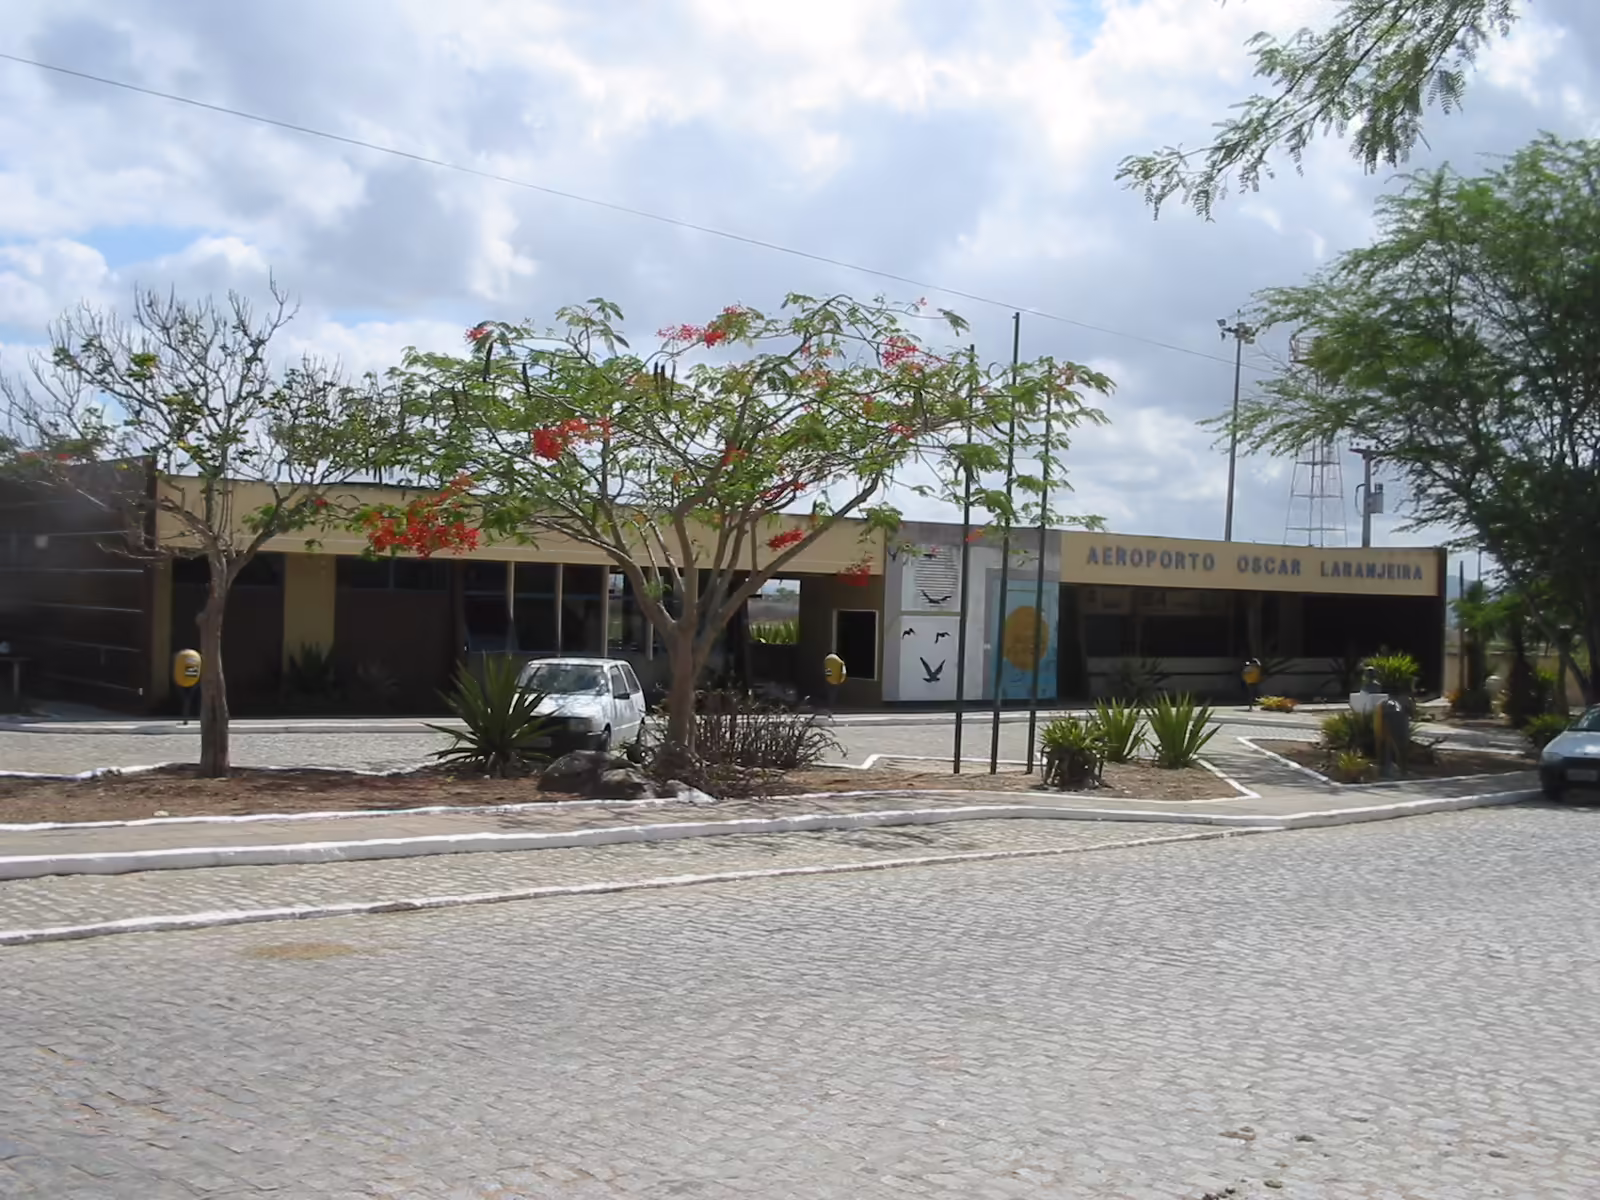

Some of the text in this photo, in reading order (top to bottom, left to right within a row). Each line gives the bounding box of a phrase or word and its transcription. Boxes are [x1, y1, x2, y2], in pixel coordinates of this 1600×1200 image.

[1087, 546, 1423, 580] AEROPORTO OSCAR LARANJEIRA
